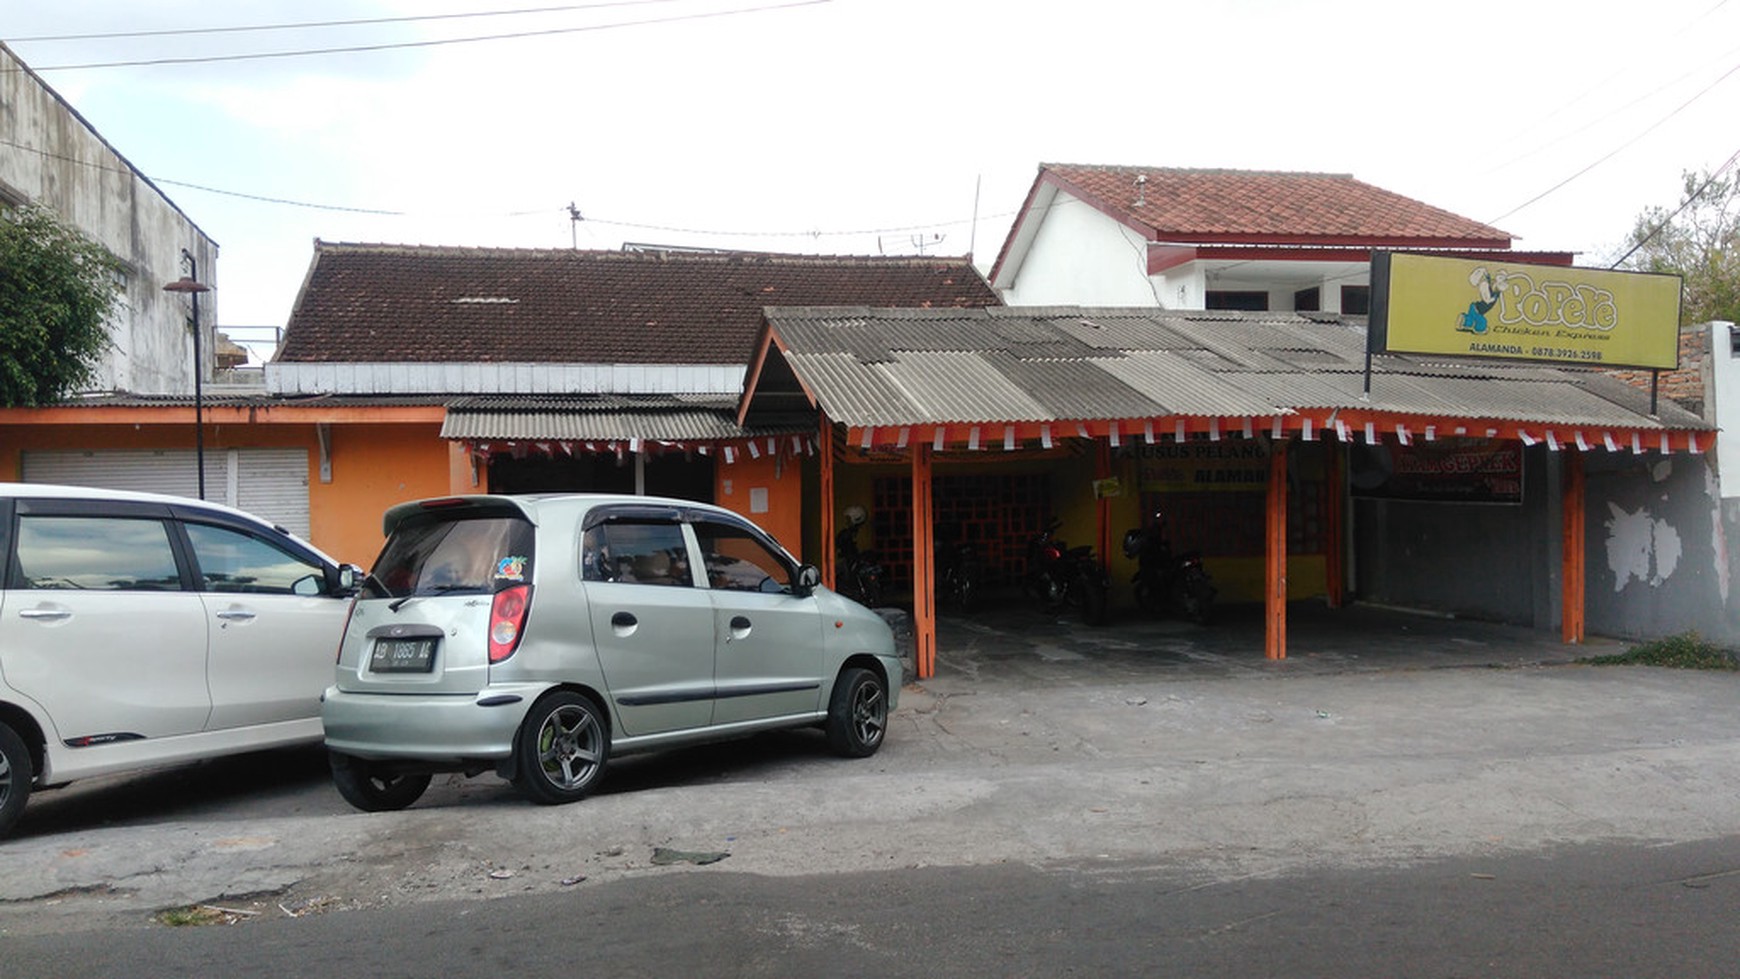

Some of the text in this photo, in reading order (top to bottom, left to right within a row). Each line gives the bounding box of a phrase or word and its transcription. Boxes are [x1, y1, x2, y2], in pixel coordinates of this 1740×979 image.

[1492, 325, 1611, 341] Chicken Express
[1469, 342, 1523, 355] ALAMANDA
[374, 642, 388, 659] AB
